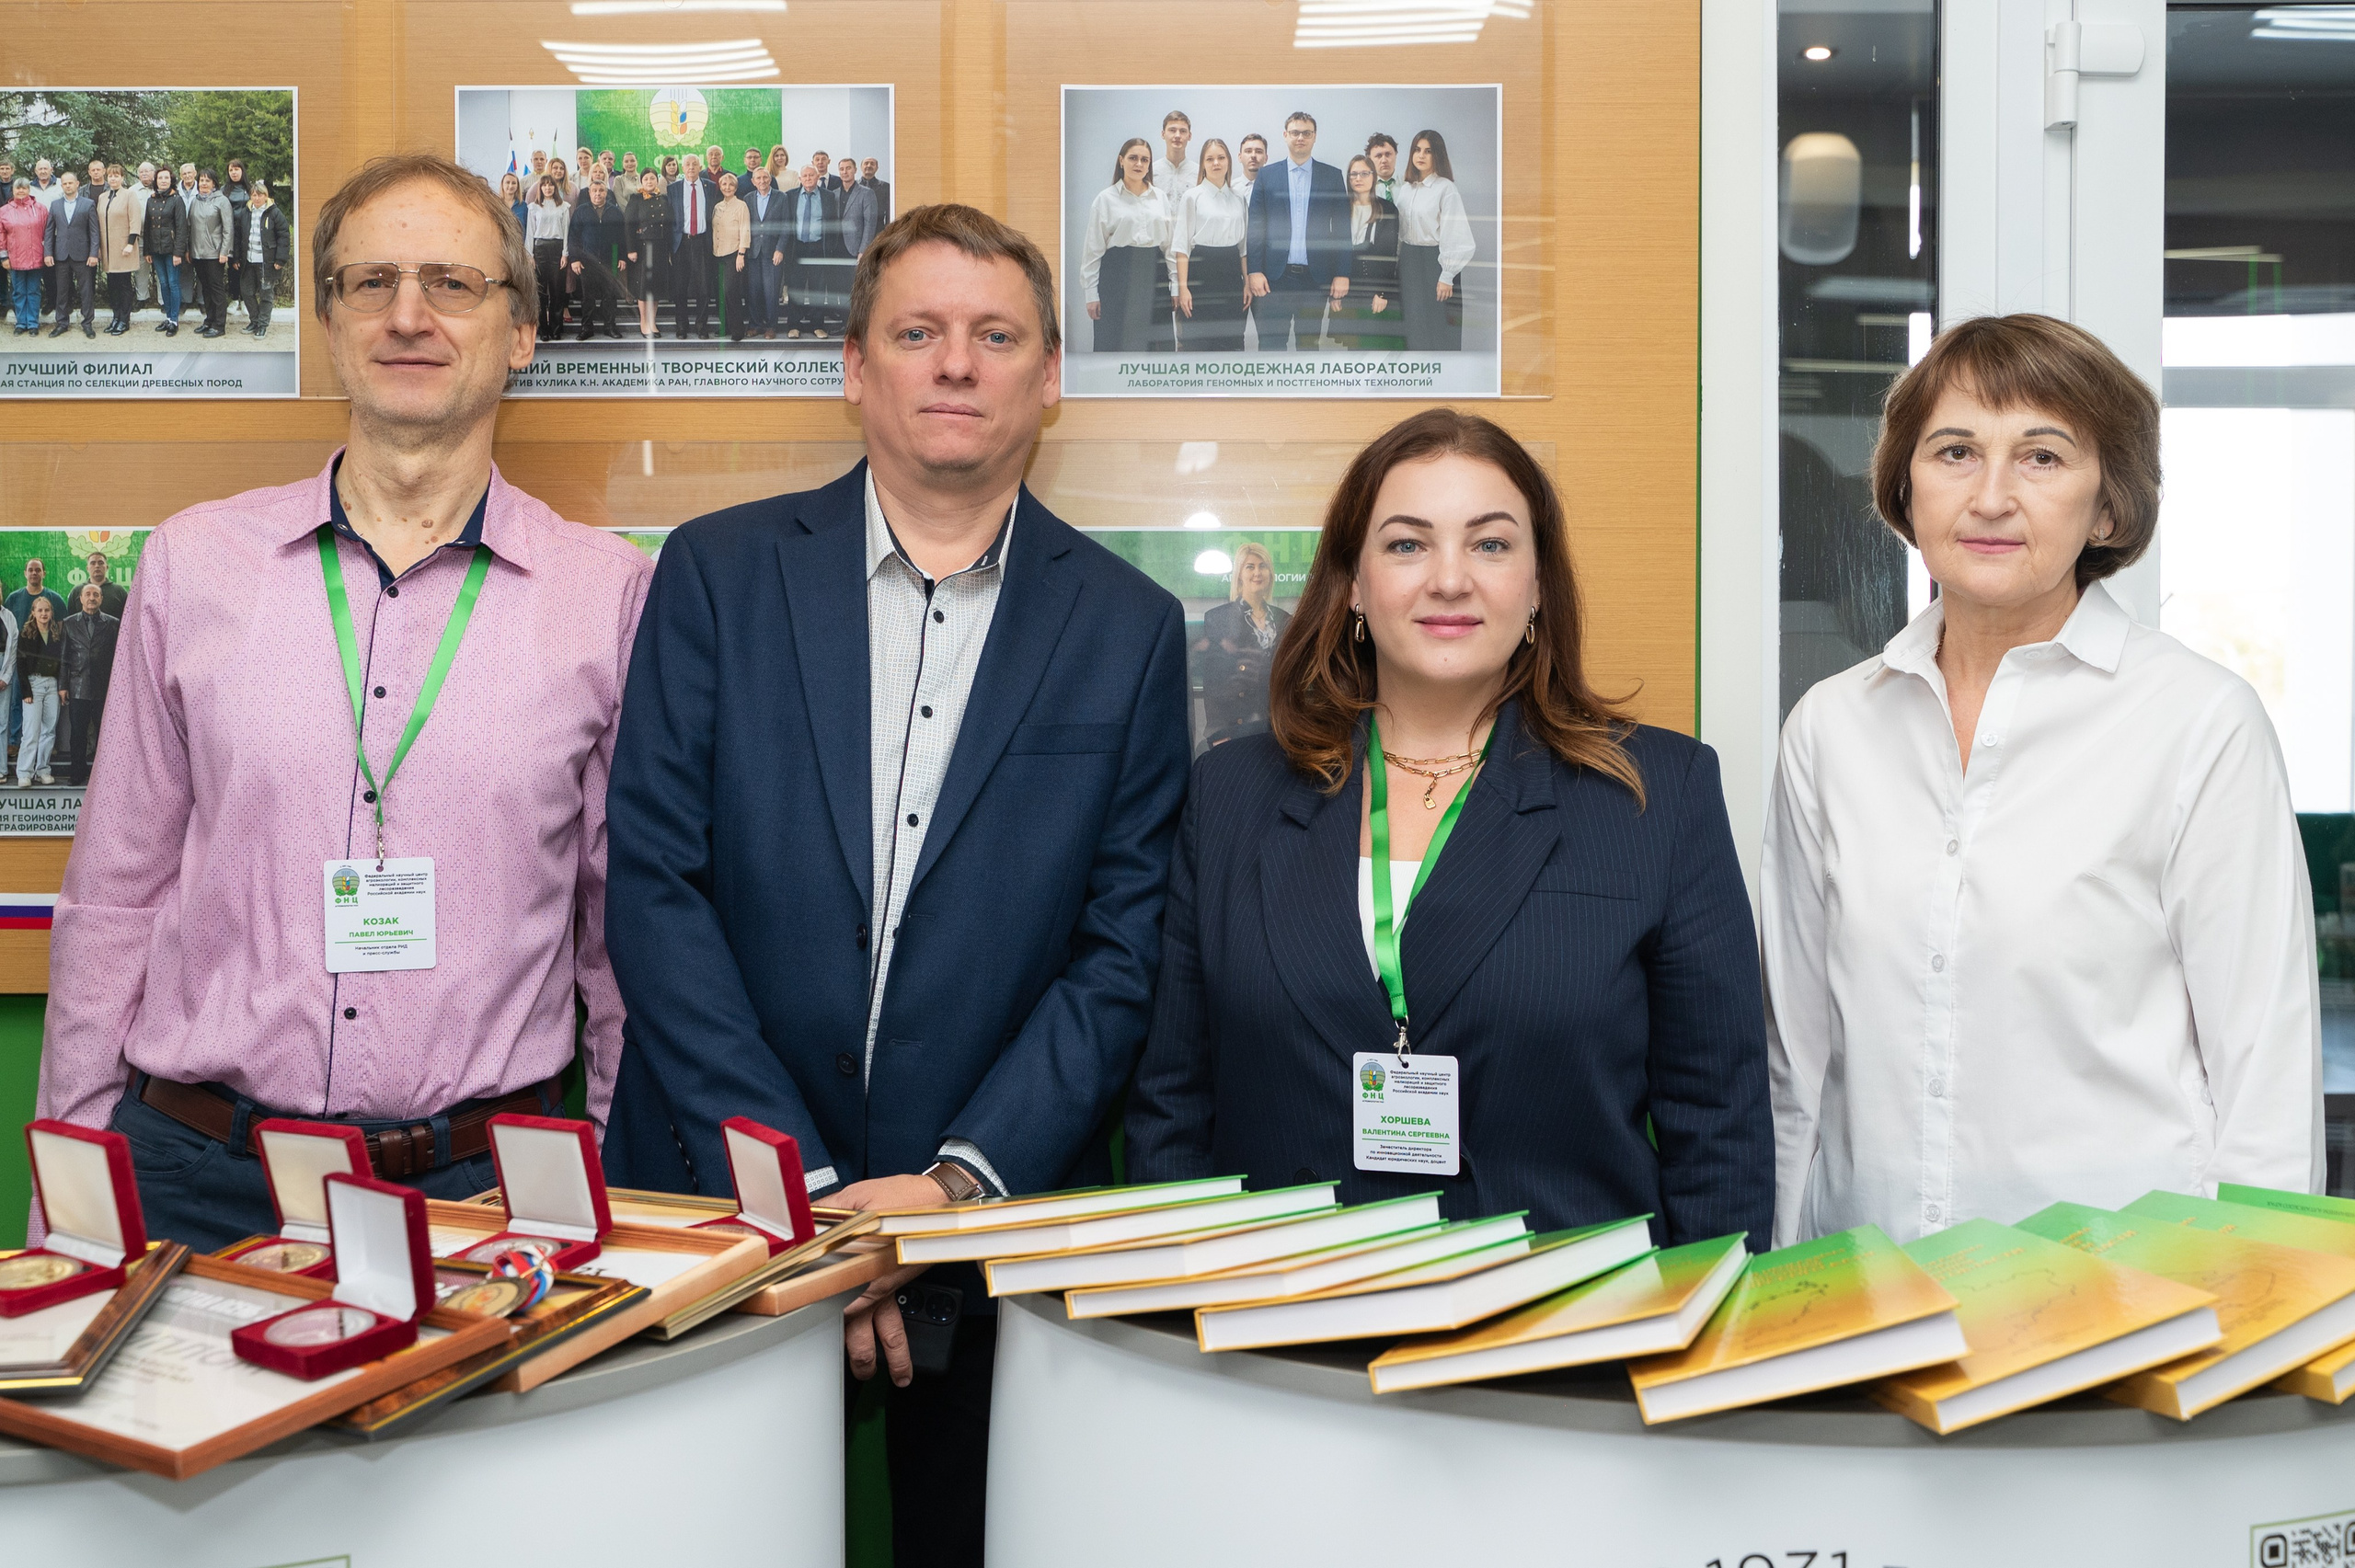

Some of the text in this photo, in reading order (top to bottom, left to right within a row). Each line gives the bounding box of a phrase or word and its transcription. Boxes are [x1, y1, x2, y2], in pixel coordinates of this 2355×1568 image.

[6, 361, 153, 375] ЛУЧШИЙ ФИЛИАЛ
[557, 360, 656, 374] ВРЕМЕННЫЙ
[661, 359, 768, 373] ТВОРЧЕСКИЙ
[1118, 363, 1442, 376] ЛУЧШАЯ МОЛОДЕЖНАЯ ЛАБОРАТОРИЯ
[17, 380, 64, 389] СТАНЦИЯ
[86, 380, 139, 389] СЕЛЕКЦИИ
[142, 380, 203, 388] ДРЕВЕСНЫХ
[207, 380, 243, 388] ПОРОД
[602, 379, 665, 387] АКАДЕМИКА
[669, 378, 691, 387] РАН,
[1364, 377, 1432, 386] ТЕХНОЛОГИЙ
[363, 917, 399, 925] КОЗАК
[1381, 1116, 1430, 1126] ХОРШЕВА
[1362, 1128, 1407, 1137] ВАЛЕНТИНА
